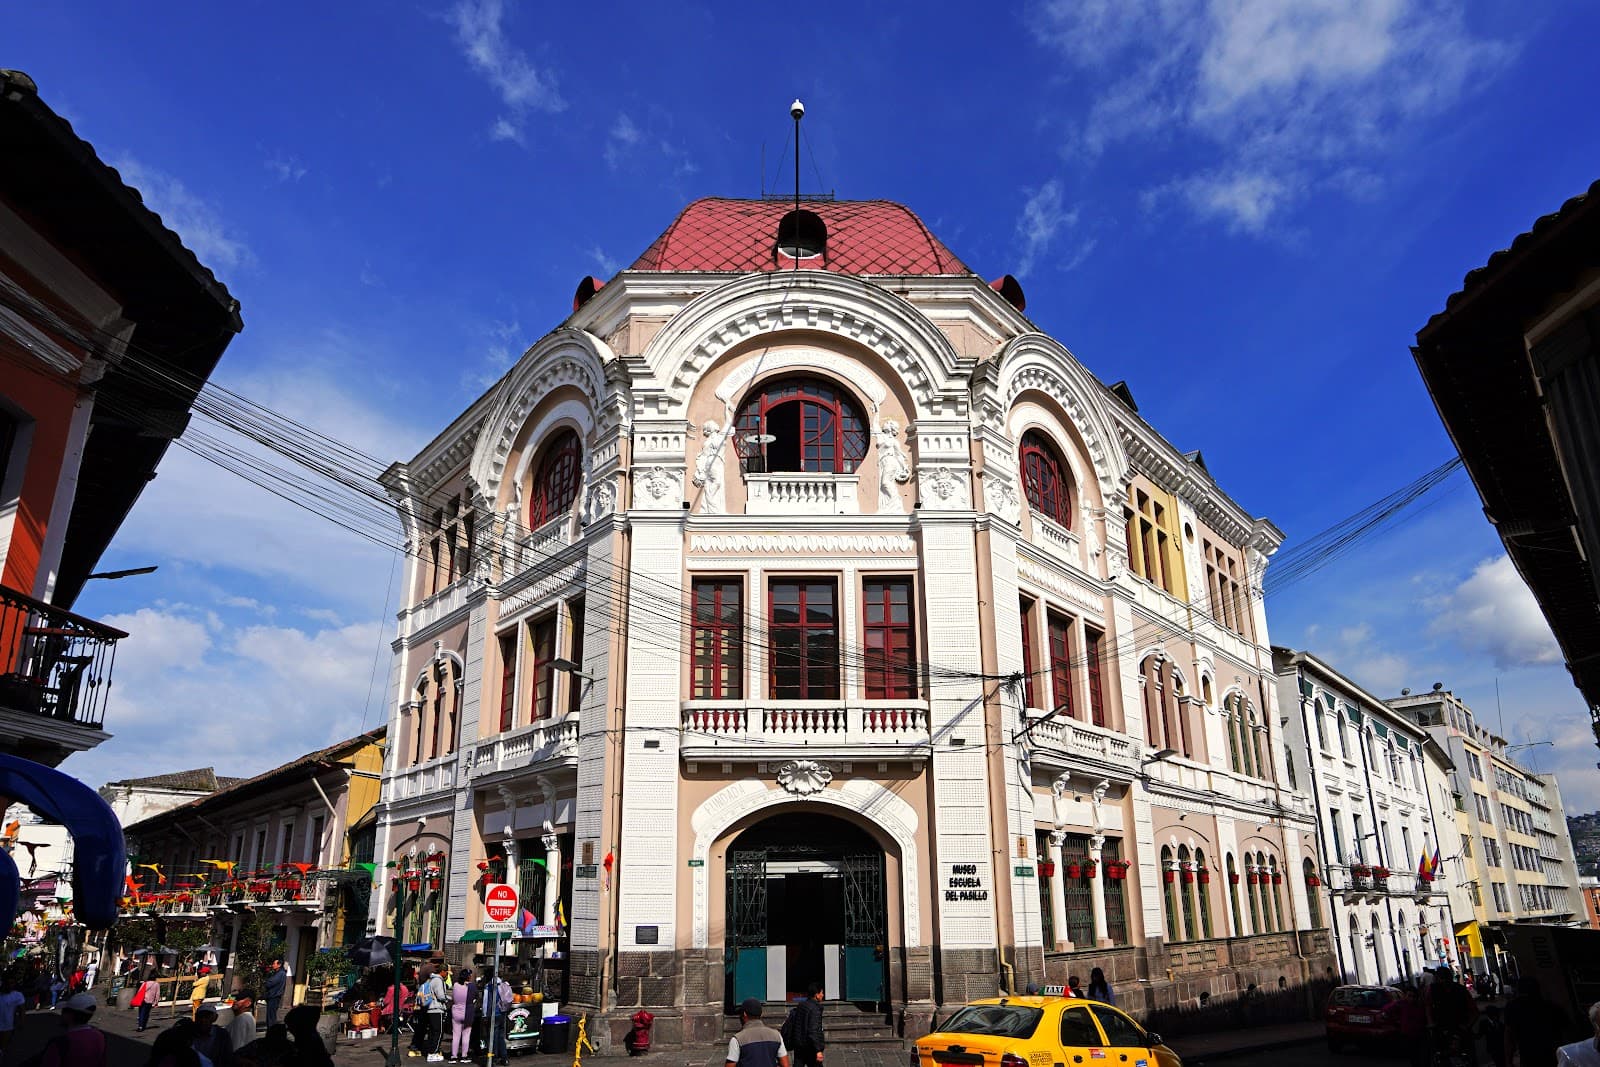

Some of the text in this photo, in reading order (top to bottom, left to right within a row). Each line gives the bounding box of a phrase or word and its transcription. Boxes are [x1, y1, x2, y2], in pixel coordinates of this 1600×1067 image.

[952, 864, 976, 874] MUSEO
[949, 877, 981, 887] ESCUELA
[497, 890, 507, 898] NO
[945, 891, 988, 901] DEL PASILLO
[490, 908, 512, 916] ENTRE
[1046, 986, 1064, 994] TAXI
